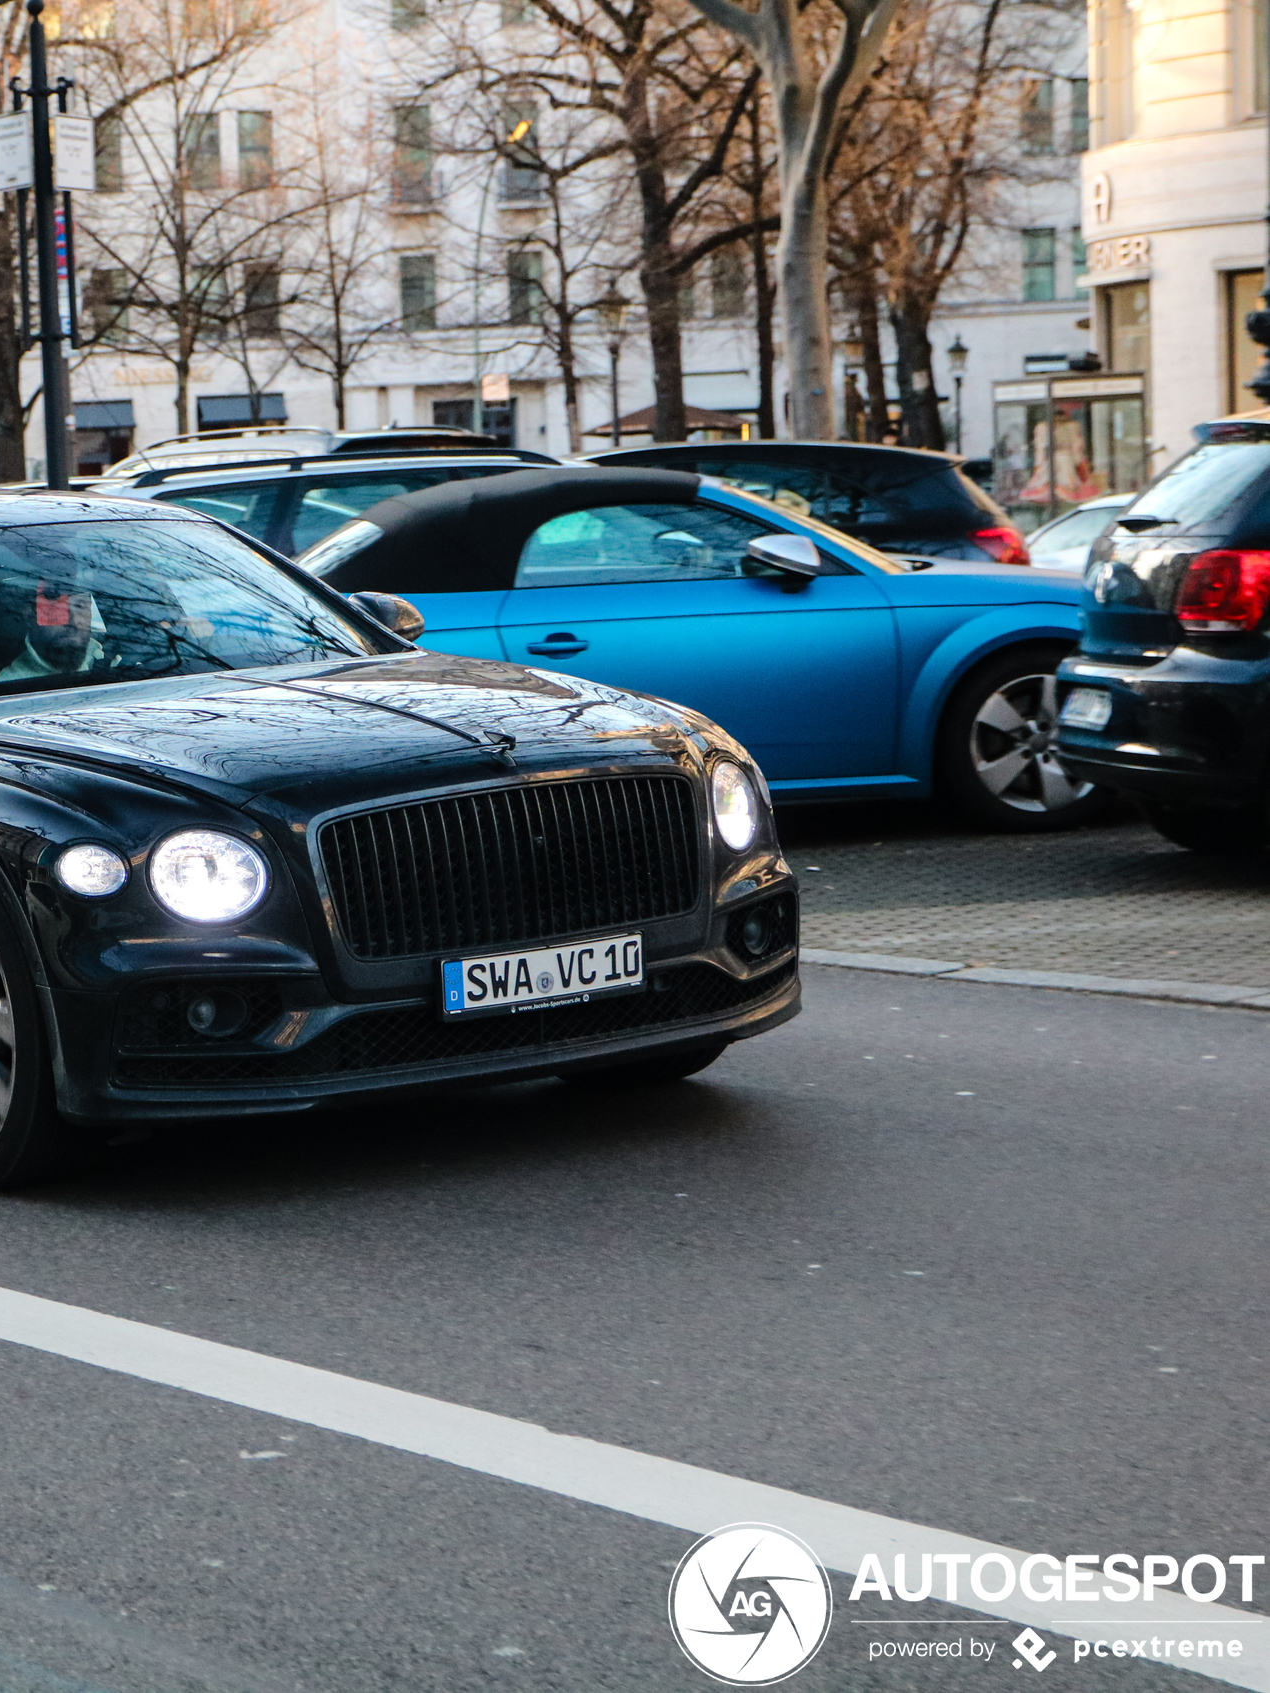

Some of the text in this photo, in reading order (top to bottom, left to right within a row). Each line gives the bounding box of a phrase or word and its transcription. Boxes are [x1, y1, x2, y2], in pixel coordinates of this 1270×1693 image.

[467, 940, 640, 1002] SWA VC 10
[451, 990, 459, 1001] D
